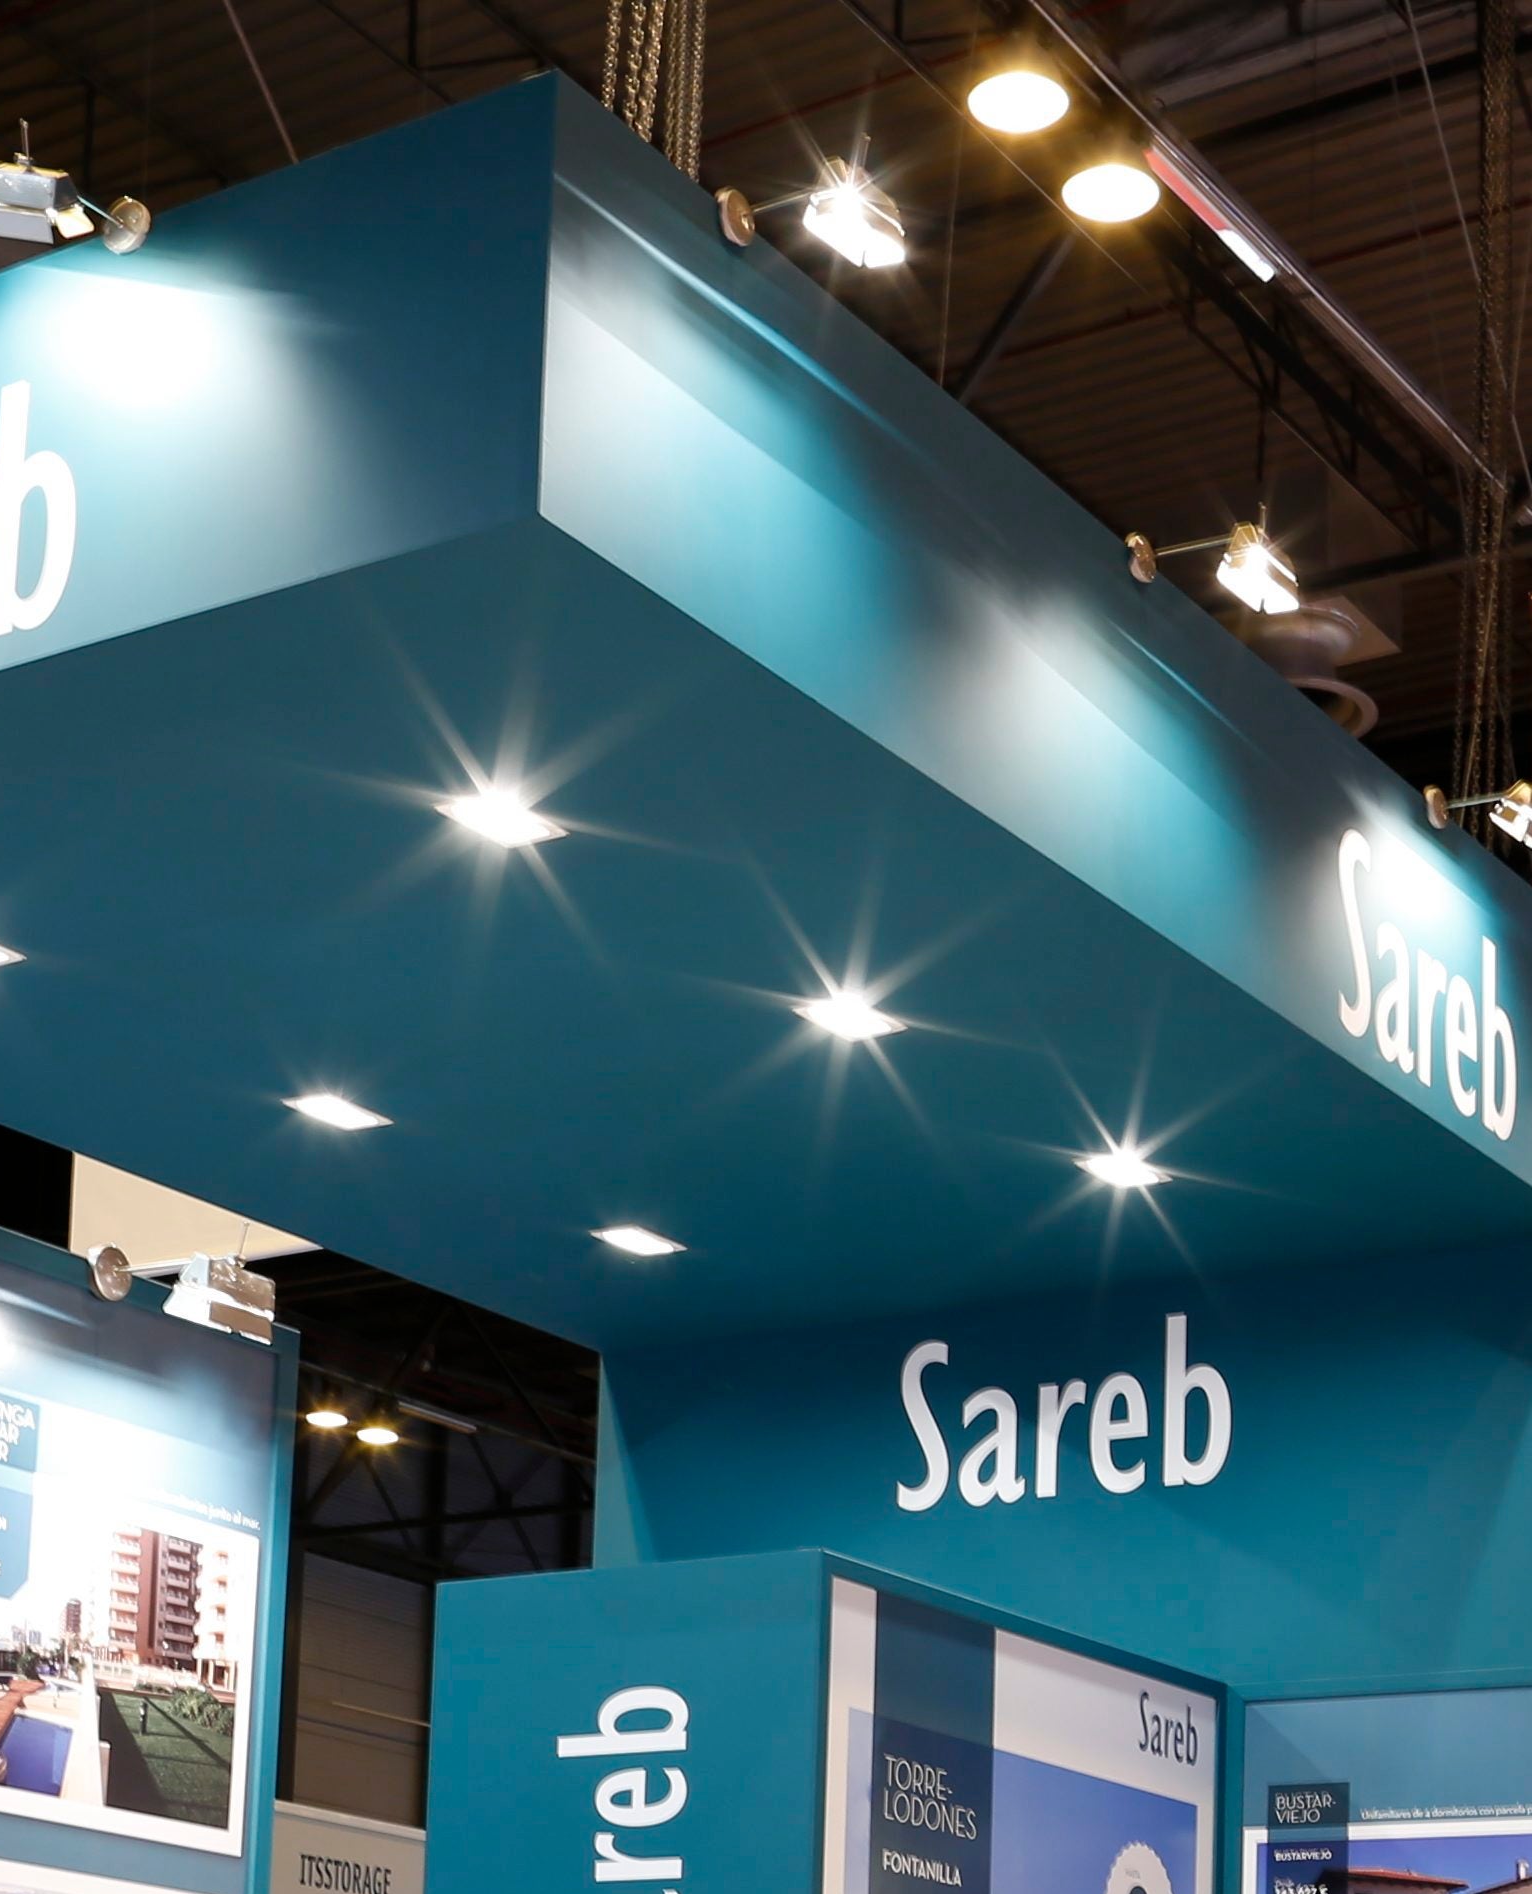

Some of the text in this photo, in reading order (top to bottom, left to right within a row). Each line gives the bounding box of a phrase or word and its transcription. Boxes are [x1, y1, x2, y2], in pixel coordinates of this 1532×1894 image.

[1338, 828, 1517, 1141] Sareb
[896, 1311, 1232, 1512] Sareb
[1137, 1690, 1199, 1767] Sareb
[883, 1753, 953, 1801] TORRE-
[884, 1788, 977, 1840] LODONES
[1275, 1793, 1336, 1810] BUSTAR-
[1276, 1808, 1320, 1824] VIEJO
[882, 1849, 962, 1888] FONTANILLA
[1274, 1850, 1332, 1862] BUSTARVIEJO
